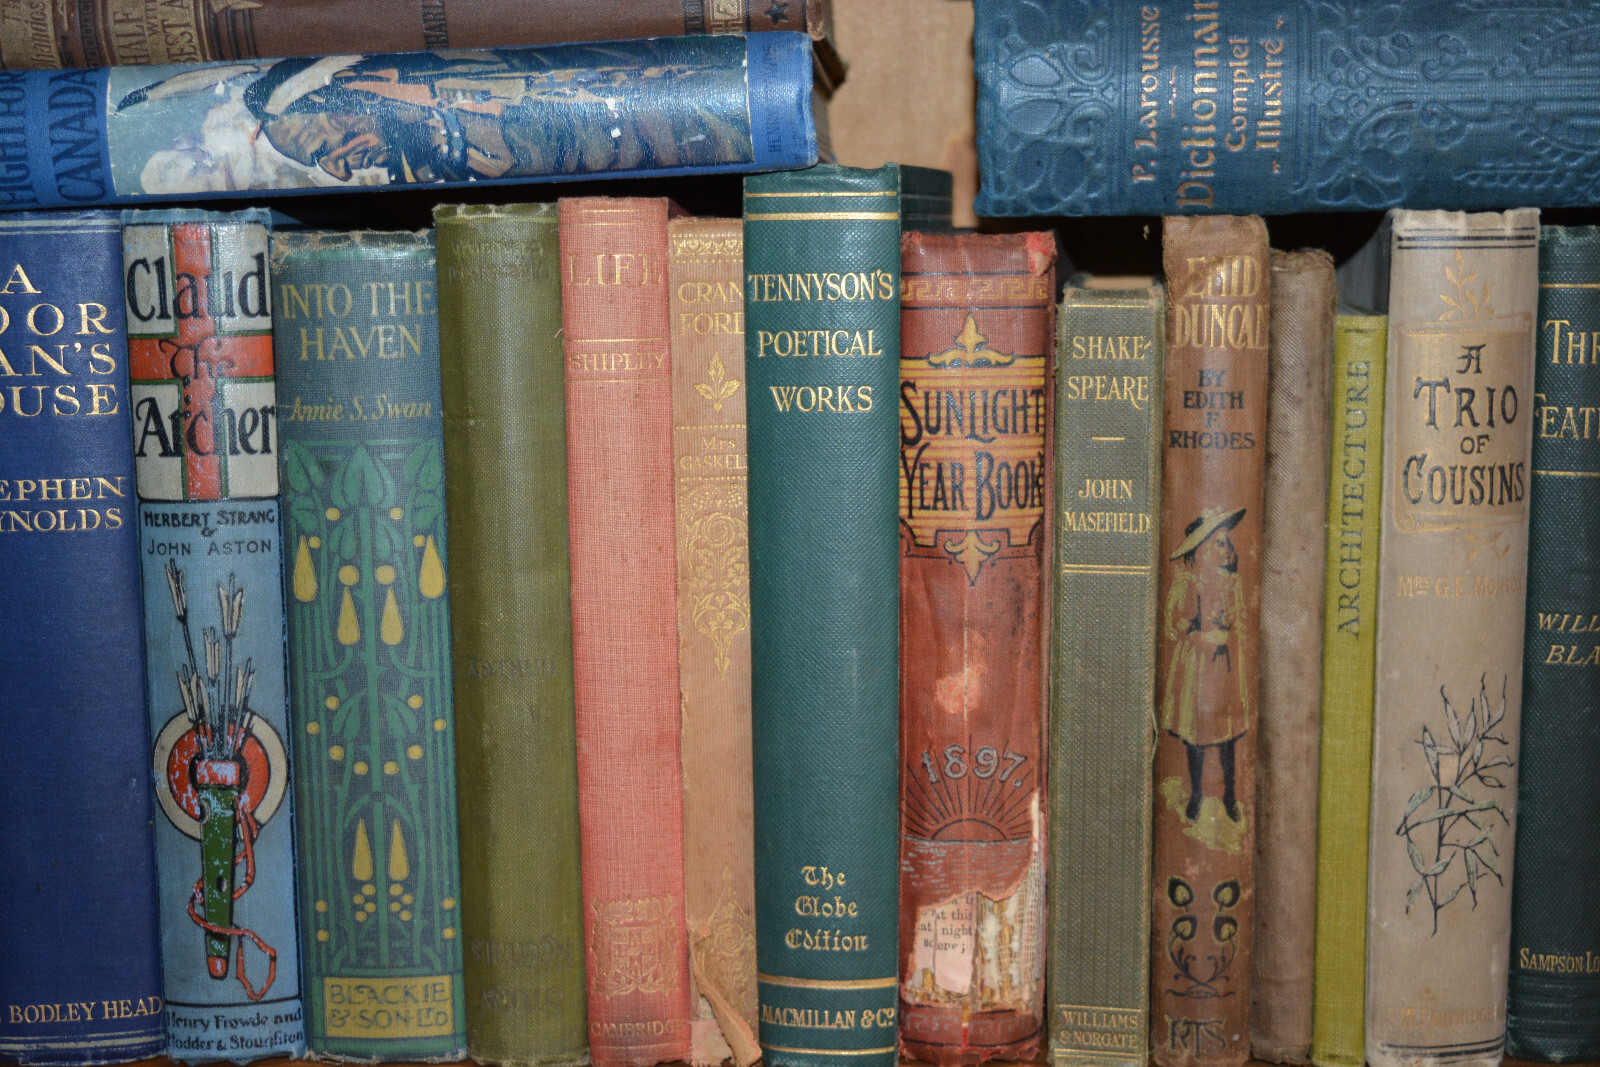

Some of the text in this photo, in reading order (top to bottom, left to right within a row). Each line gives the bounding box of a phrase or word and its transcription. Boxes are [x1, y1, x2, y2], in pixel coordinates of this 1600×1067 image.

[112, 11, 150, 65] HALF
[1131, 6, 1160, 183] P. Larousse
[1225, 35, 1255, 151] Complet
[1256, 39, 1284, 150] Illustré
[48, 68, 107, 201] CANADA
[4, 264, 42, 294] A
[127, 252, 270, 322] Claud
[749, 269, 893, 302] TENNYSON'S
[282, 281, 436, 319] INTO THE
[0, 303, 116, 336] OR
[299, 324, 422, 361] HAVEN
[758, 329, 882, 357] POETICAL
[158, 336, 234, 380] The
[1456, 344, 1487, 374] A
[1067, 374, 1149, 410] SPEARE
[1198, 370, 1228, 388] BY
[0, 384, 118, 417] USE
[288, 396, 345, 421] Annie
[371, 393, 432, 420] Swan
[770, 385, 873, 412] WORKS
[1183, 391, 1245, 409] EDITH
[1413, 376, 1518, 431] TRIO
[136, 397, 276, 457] Archer
[900, 381, 1044, 446] SUNLIGHT
[1205, 412, 1222, 428] E
[1535, 393, 1600, 438] EAT
[1169, 430, 1256, 449] RHODES
[1460, 435, 1490, 454] OF
[680, 454, 747, 470] GASKEL
[900, 442, 1044, 521] YEAR BOOK
[1078, 478, 1133, 499] JOHN
[1403, 453, 1525, 505] COUSINS
[1337, 361, 1371, 640] ARCHITECTURE
[144, 508, 275, 527] HERBERT STRANG
[1064, 511, 1150, 534] MASEFIELD
[147, 539, 272, 556] JOHN ASTON
[1544, 645, 1600, 664] BLA
[801, 866, 847, 890] The
[795, 895, 859, 917] Globe
[784, 928, 869, 951] Edition
[941, 924, 973, 939] night
[1520, 947, 1583, 973] SAMPSON
[330, 982, 449, 1005] BLACKIE
[9, 996, 163, 1024] BODLEY HEAD
[167, 1007, 302, 1032] Henry Frowde and
[761, 1004, 856, 1029] MACMILLAN
[1060, 1010, 1139, 1029] WILLIAMS
[167, 1031, 214, 1050] Hodder
[216, 1037, 227, 1050] &
[1060, 1030, 1138, 1049] & NORGATE
